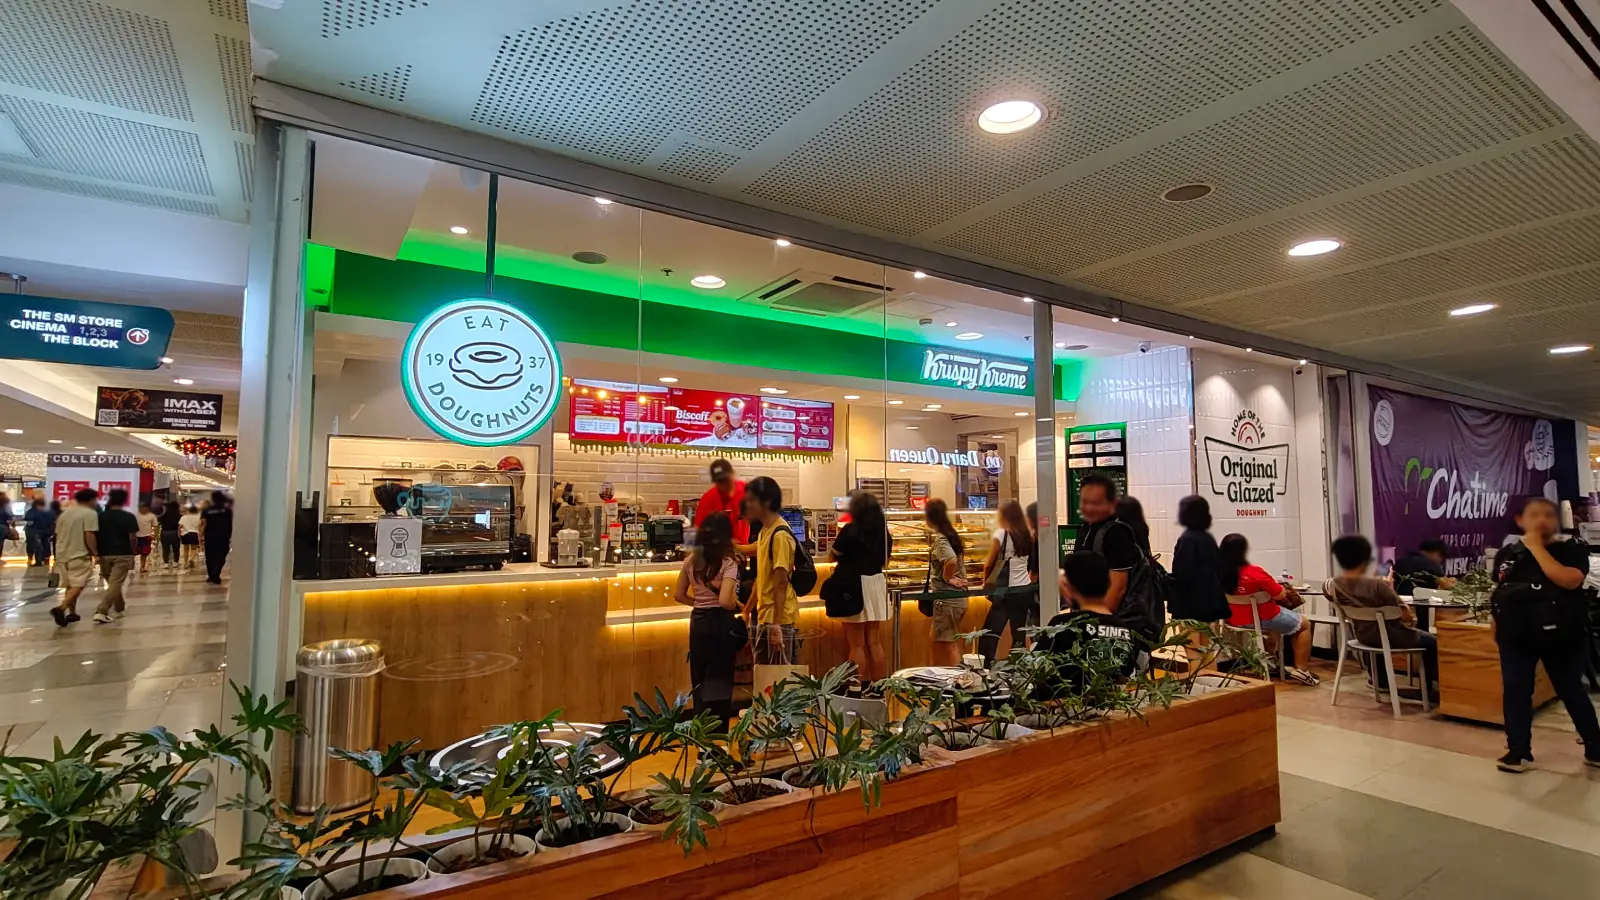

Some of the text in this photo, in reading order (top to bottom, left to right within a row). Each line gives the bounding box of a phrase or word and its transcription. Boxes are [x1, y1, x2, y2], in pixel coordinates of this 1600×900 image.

[22, 309, 123, 328] THE SM STORE
[464, 315, 509, 331] EAT
[10, 319, 108, 337] CINEMA 1,2,3
[42, 333, 119, 349] THE BLOCK
[426, 353, 546, 369] 19 37
[923, 350, 1029, 389] Krispy Kreme
[164, 398, 217, 410] IMAX
[428, 382, 544, 428] DOUGHNUTS
[675, 409, 711, 422] Biscoff
[1231, 409, 1247, 437] HOME
[1247, 410, 1256, 421] OF
[53, 454, 135, 464] COLLECTION
[1220, 455, 1278, 483] Original
[1227, 481, 1275, 503] Glazed
[1426, 466, 1508, 520] Chatime
[1236, 508, 1267, 517] DOUGHNUT
[1460, 534, 1470, 547] OF
[1445, 556, 1468, 576] NEW
